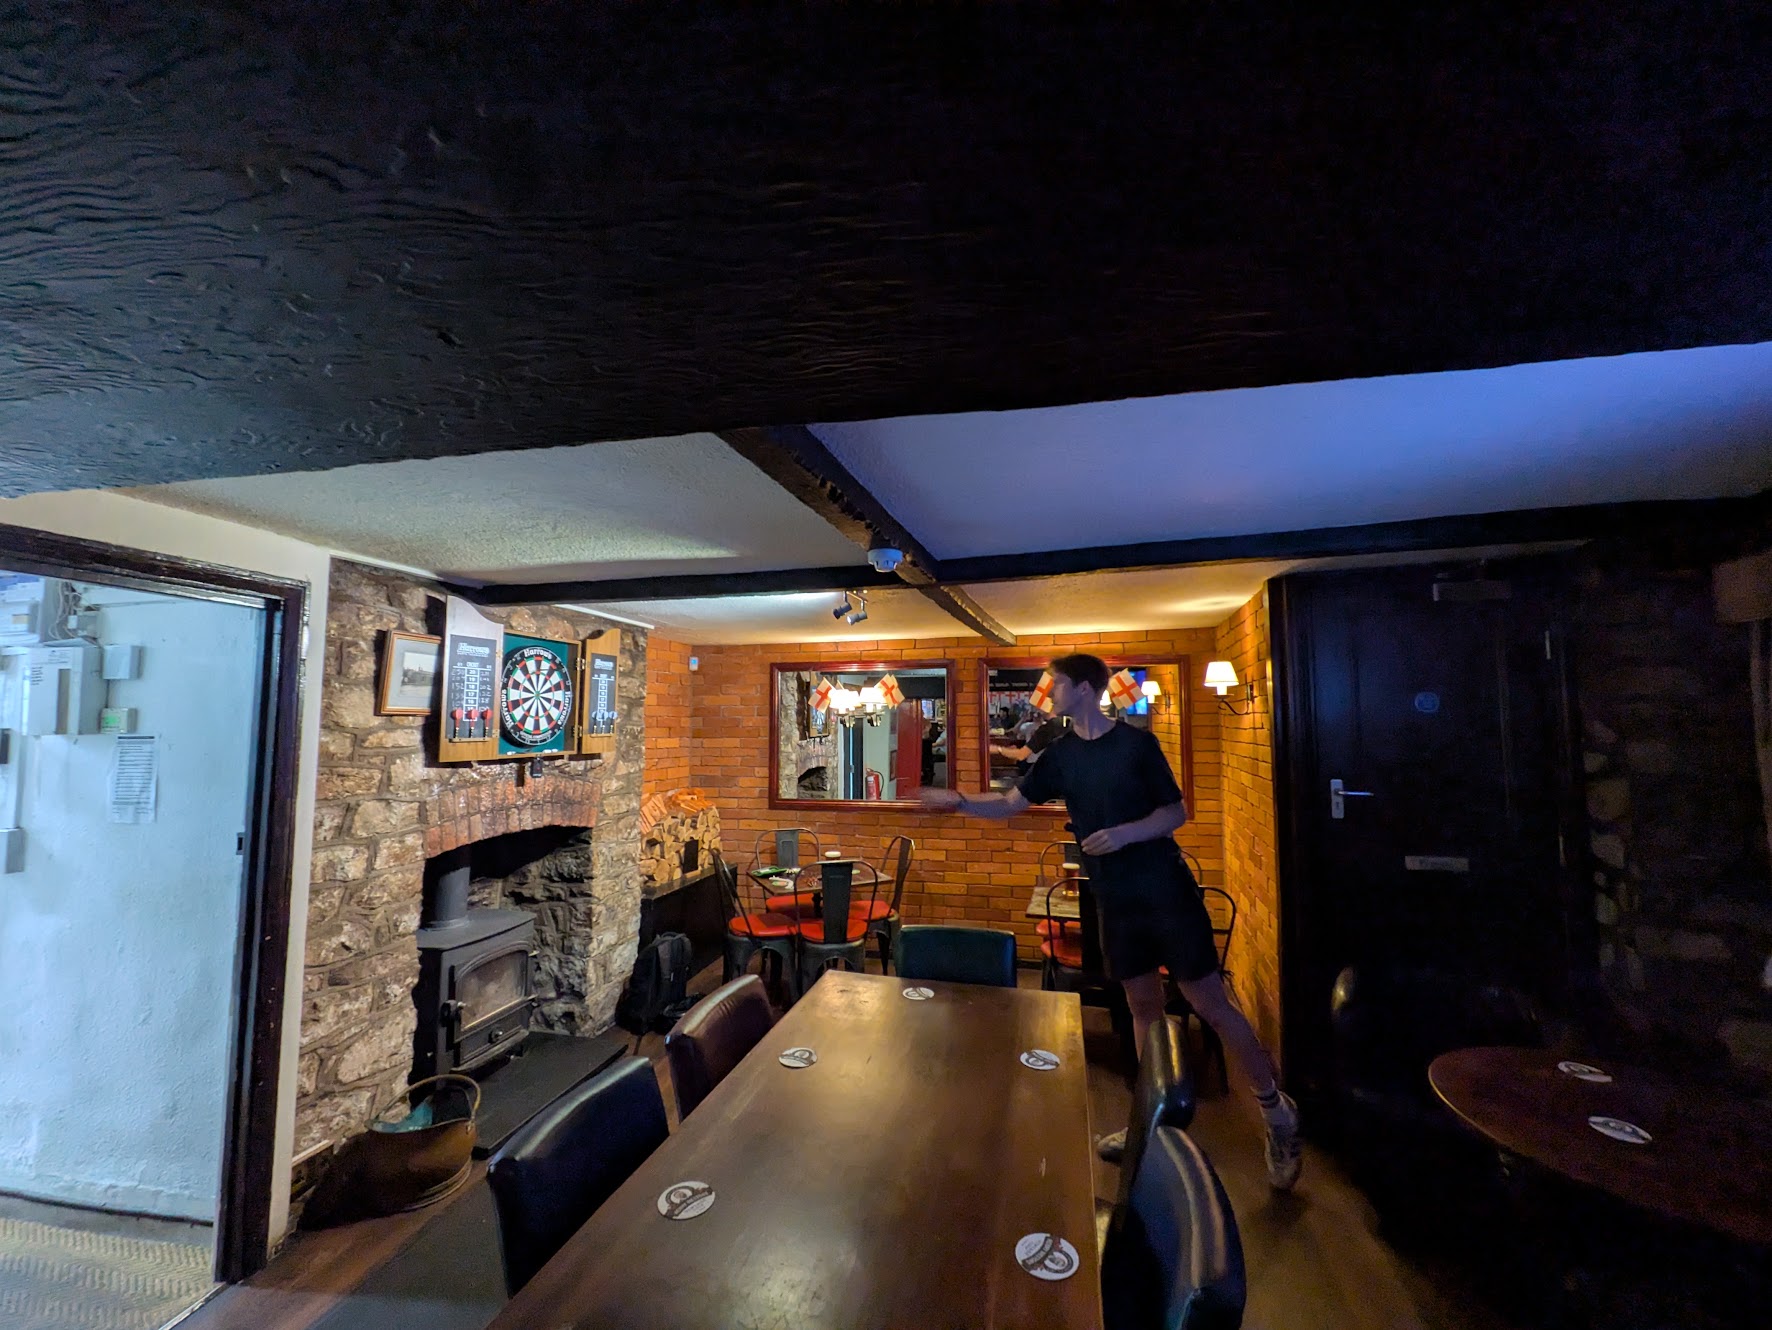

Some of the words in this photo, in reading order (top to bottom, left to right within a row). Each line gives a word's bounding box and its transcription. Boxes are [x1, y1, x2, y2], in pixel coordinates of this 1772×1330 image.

[523, 648, 553, 660] Harrows
[501, 689, 514, 730] Harrows
[557, 691, 571, 725] Harrows
